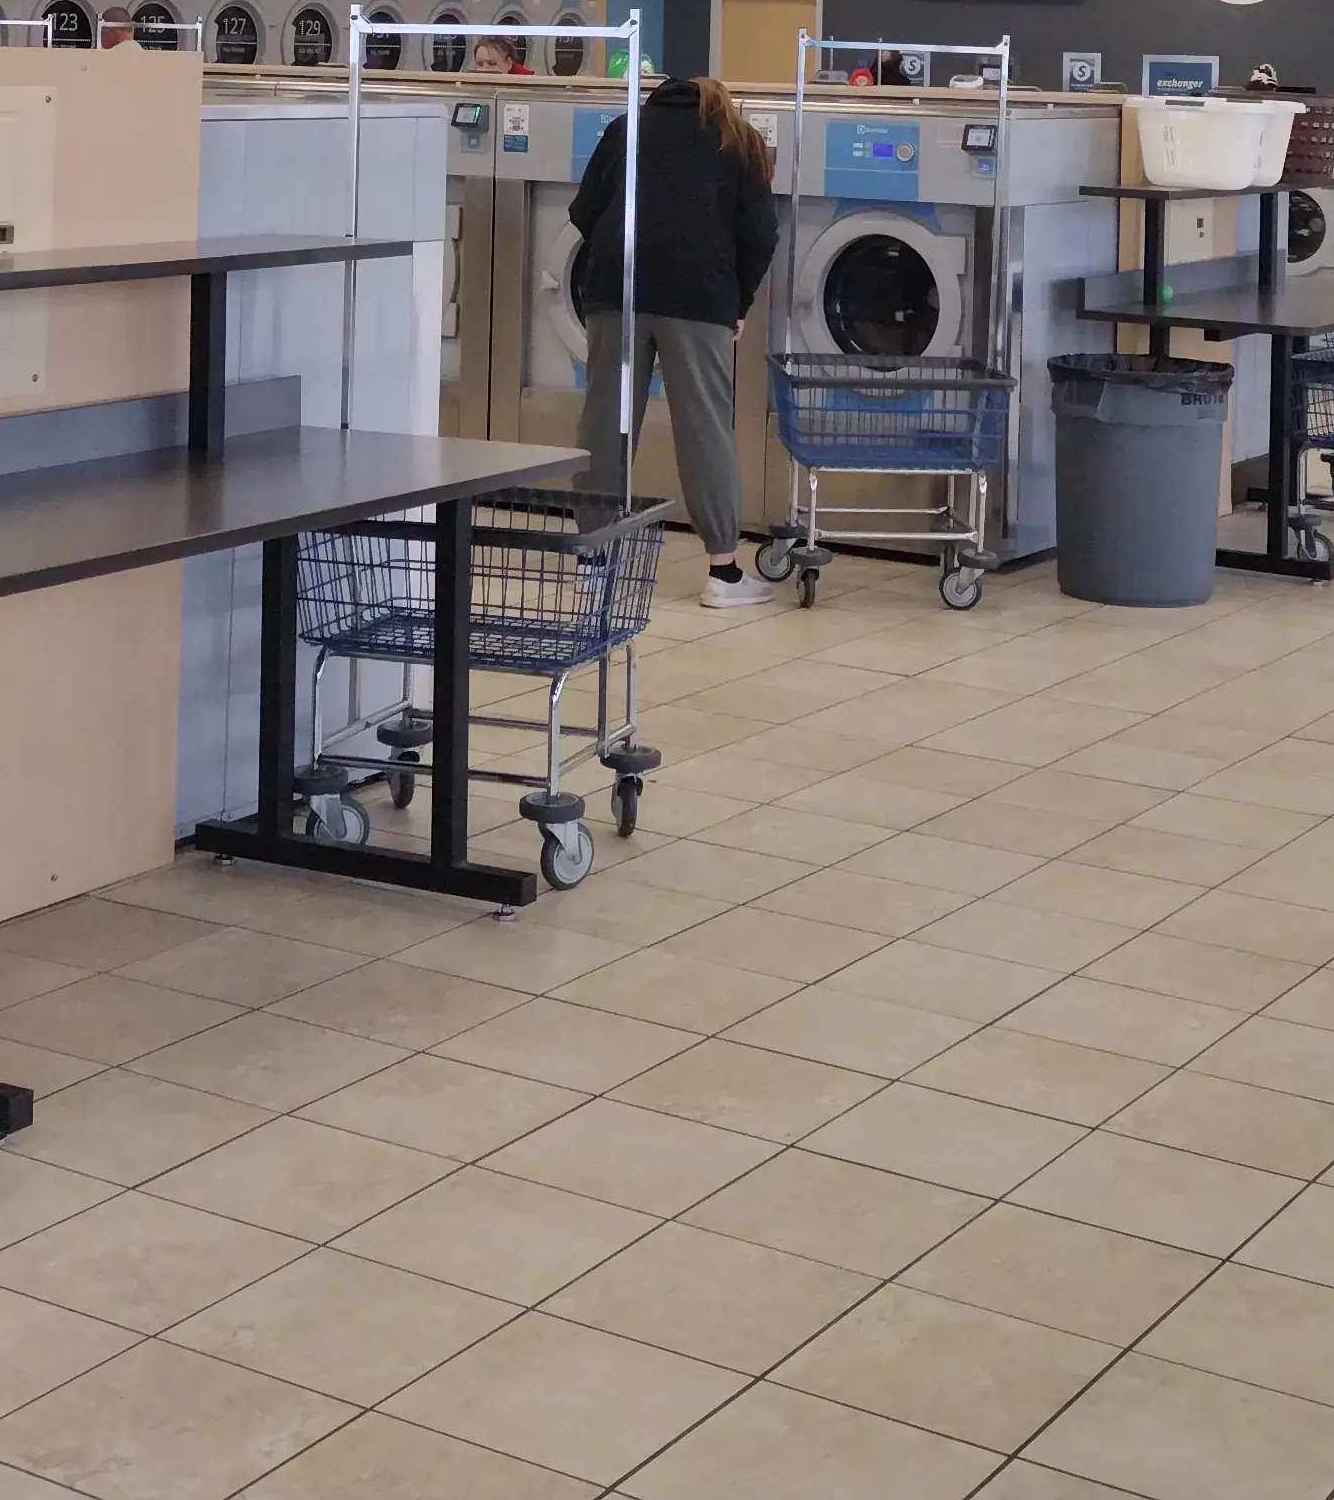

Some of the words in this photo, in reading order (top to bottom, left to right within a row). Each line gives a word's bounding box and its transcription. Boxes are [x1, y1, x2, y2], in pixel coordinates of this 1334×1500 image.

[51, 12, 78, 31] 123
[140, 15, 165, 34] 125
[222, 17, 247, 35] 127
[299, 19, 321, 37] 129
[1156, 78, 1204, 90] exchanger
